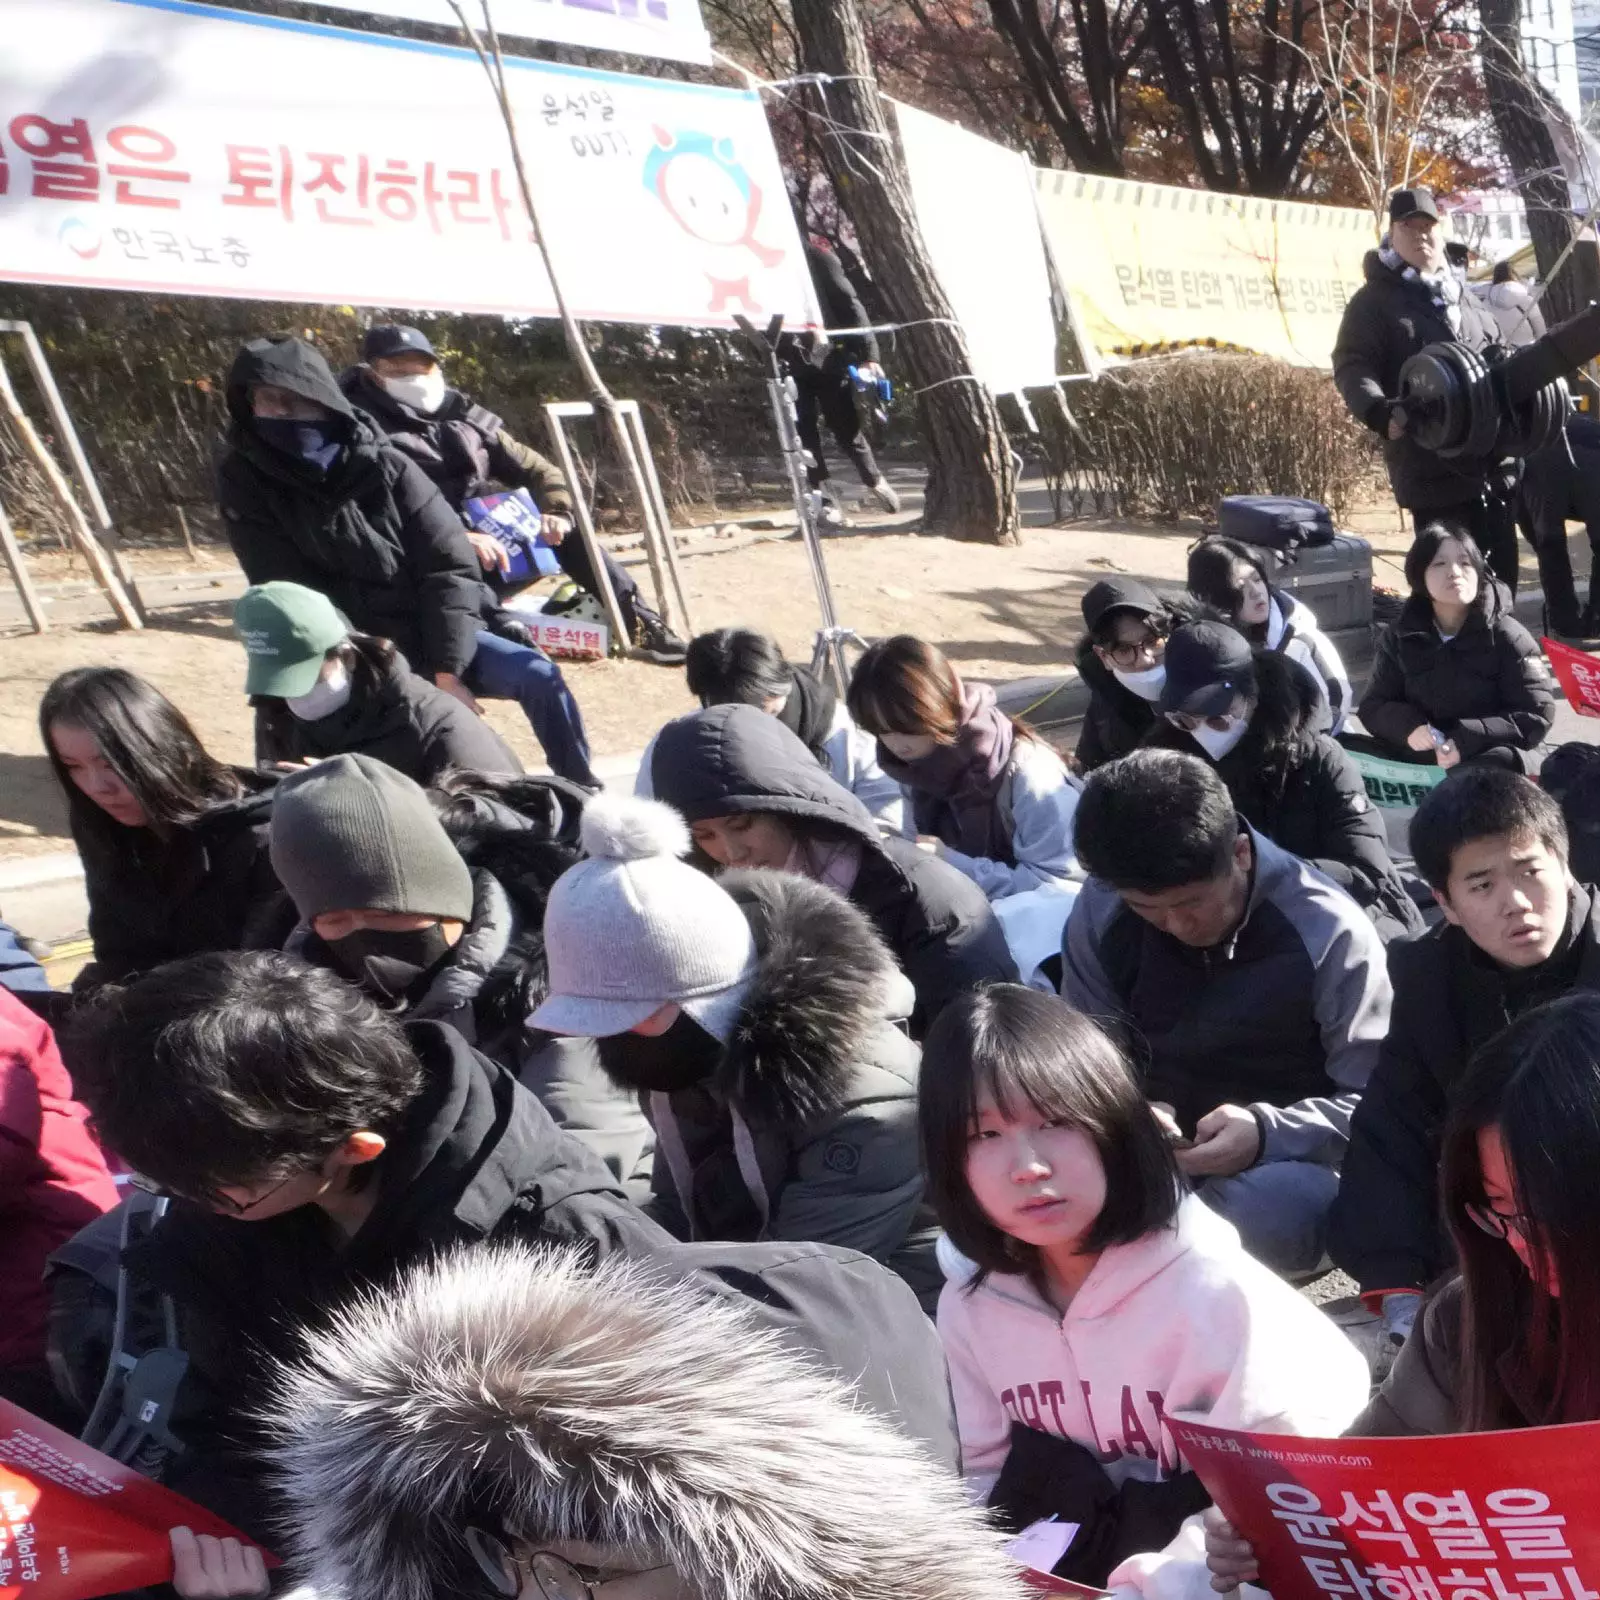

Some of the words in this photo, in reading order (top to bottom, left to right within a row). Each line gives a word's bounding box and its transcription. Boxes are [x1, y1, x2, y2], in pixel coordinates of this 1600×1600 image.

[540, 86, 616, 126] 윤석열
[0, 113, 192, 210] 열은
[570, 129, 633, 158] OUT!
[1114, 264, 1178, 308] 윤석열
[1180, 270, 1226, 310] 탄핵
[545, 626, 600, 645] 윤석열
[1247, 1447, 1373, 1468] www.nanum.com
[1265, 1481, 1574, 1560] 윤석열을
